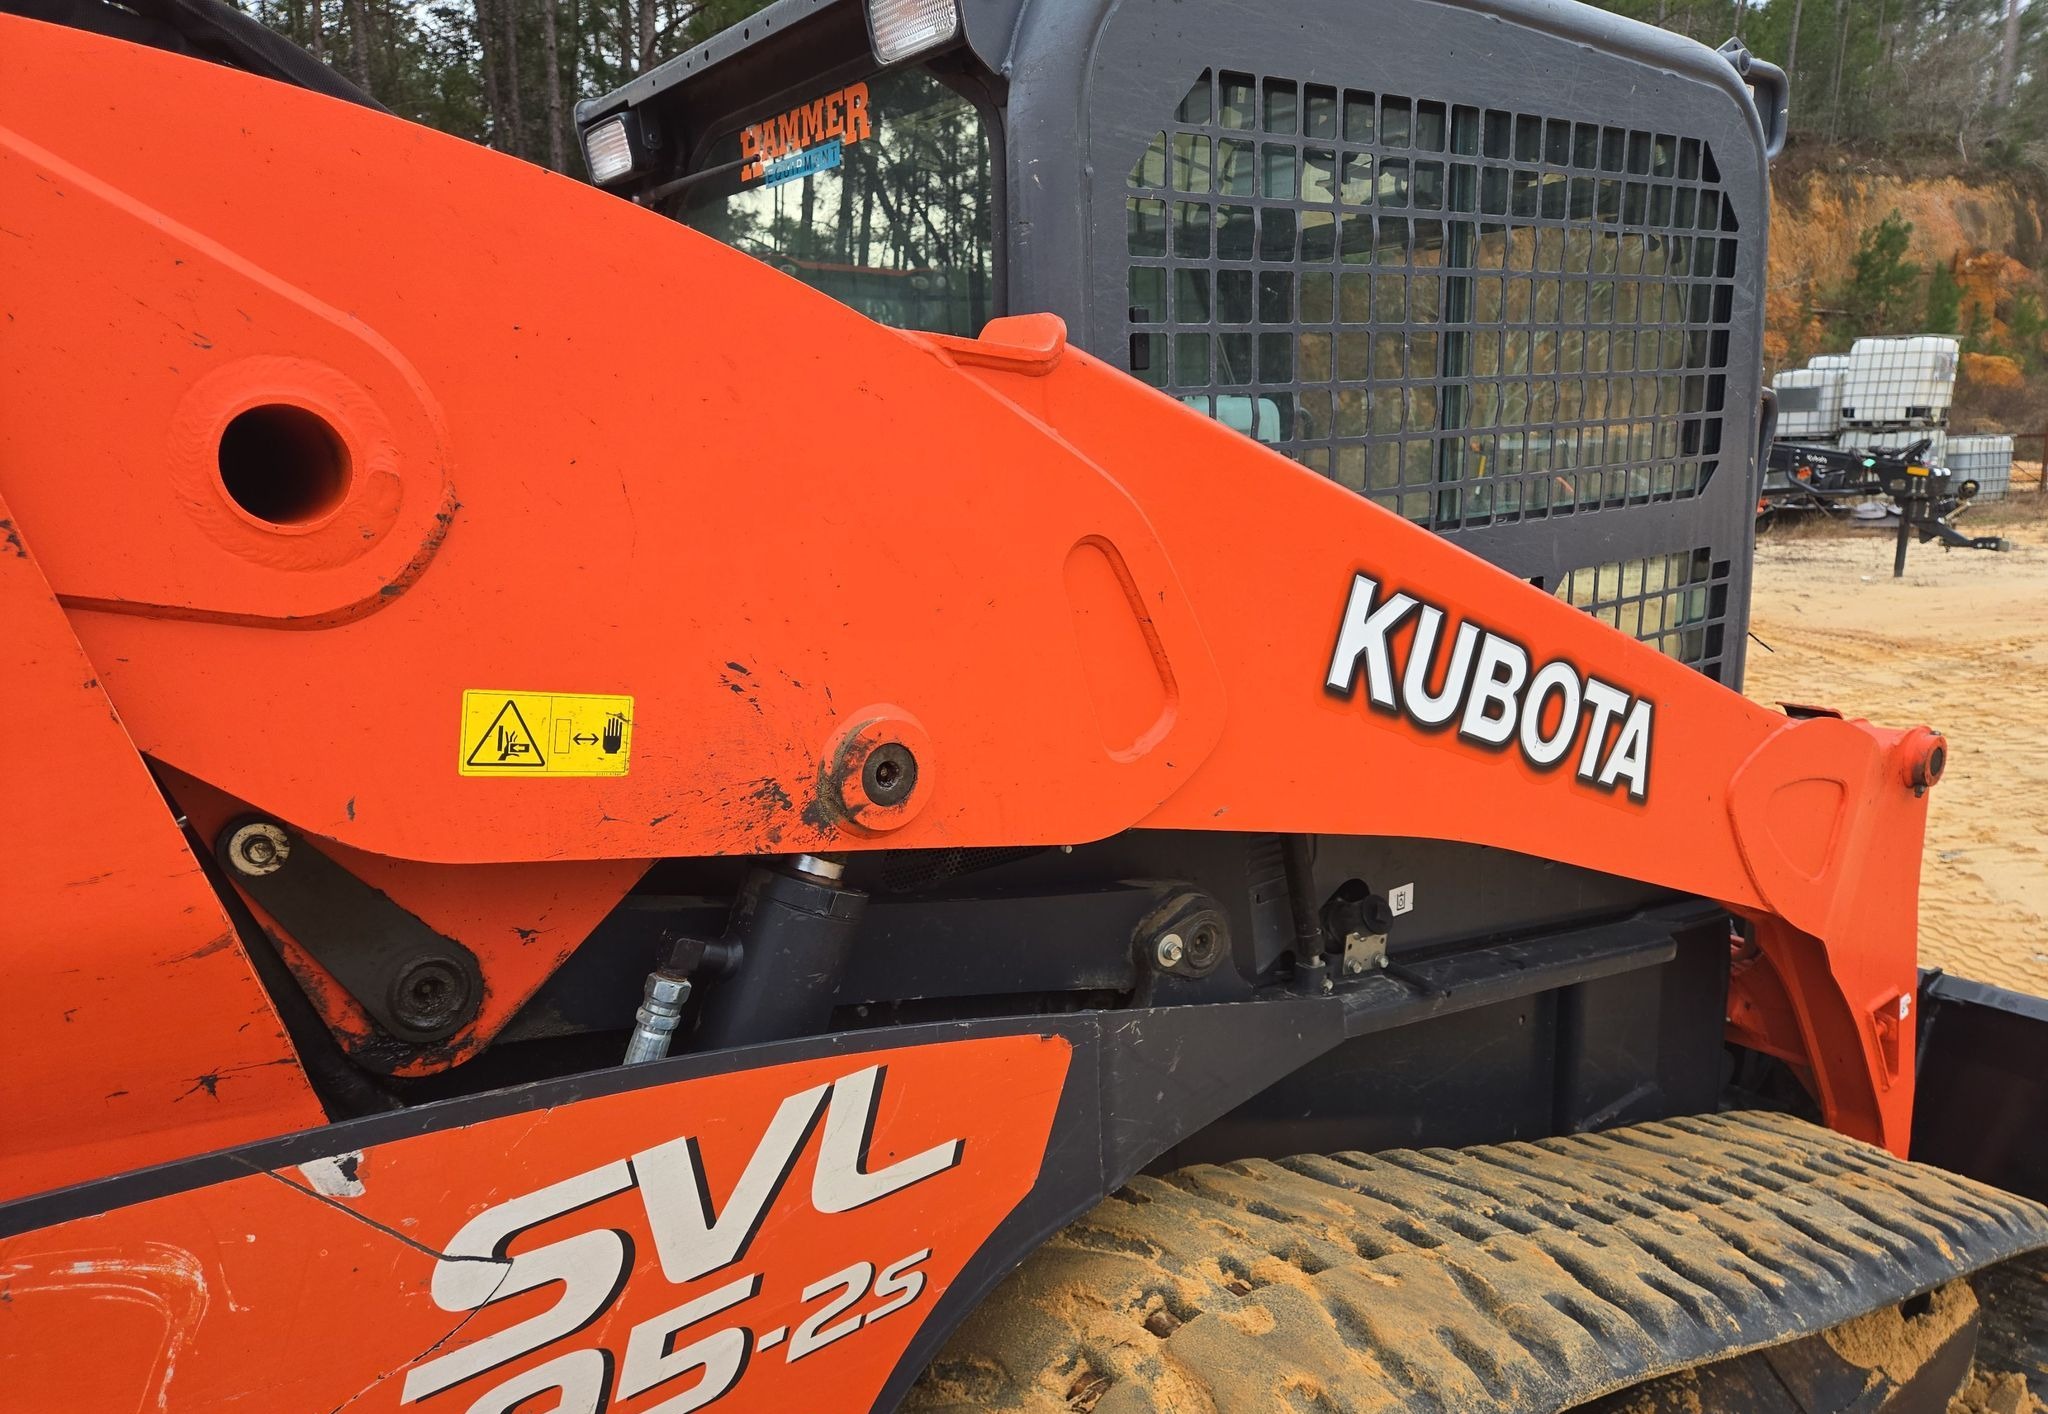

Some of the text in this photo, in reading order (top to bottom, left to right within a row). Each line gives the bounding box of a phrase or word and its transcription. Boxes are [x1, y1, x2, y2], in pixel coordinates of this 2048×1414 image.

[740, 82, 871, 182] HAMMER
[767, 145, 838, 184] EQUIPMENT
[1325, 573, 1654, 800] KUBOTA
[400, 1064, 965, 1406] SVL
